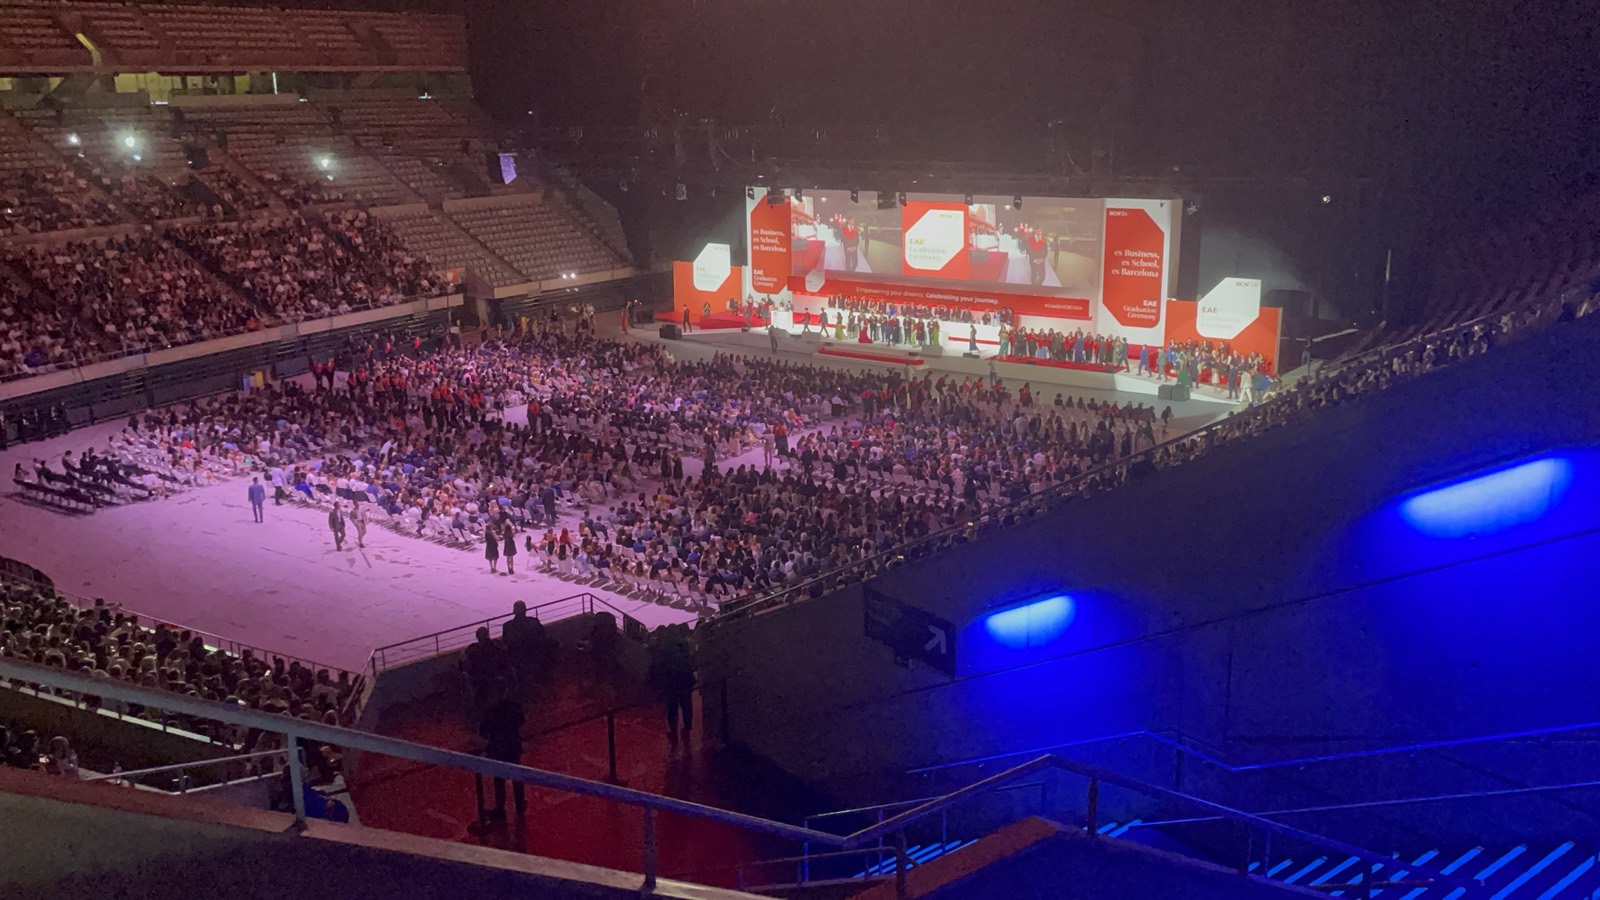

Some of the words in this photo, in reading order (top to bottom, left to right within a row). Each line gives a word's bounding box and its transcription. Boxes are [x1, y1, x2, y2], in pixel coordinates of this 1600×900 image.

[760, 236, 780, 244] School,
[1124, 249, 1160, 259] Business,
[1131, 259, 1160, 268] School,
[1121, 268, 1159, 278] Barcelona
[856, 286, 890, 296] Empowering
[925, 293, 959, 302] Celebrating
[974, 296, 1000, 305] journey.
[1123, 304, 1157, 314] Graduation
[1127, 312, 1156, 321] Ceremony
